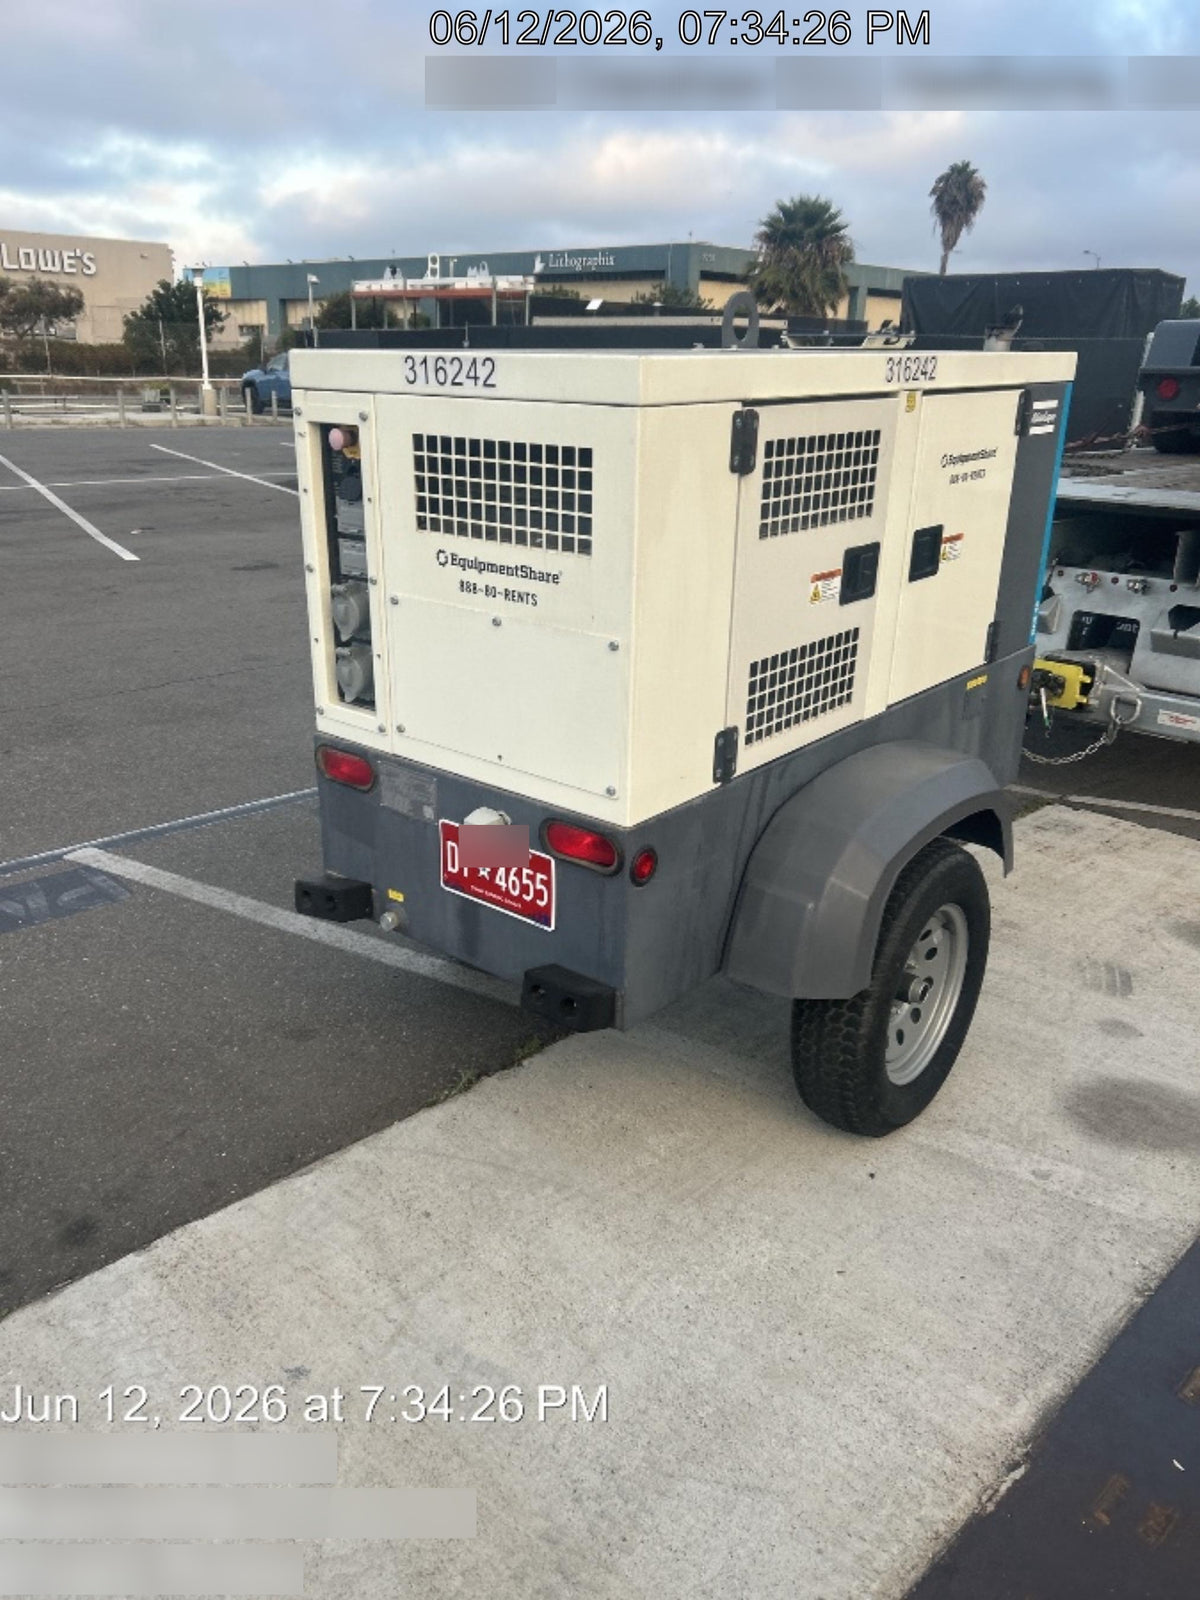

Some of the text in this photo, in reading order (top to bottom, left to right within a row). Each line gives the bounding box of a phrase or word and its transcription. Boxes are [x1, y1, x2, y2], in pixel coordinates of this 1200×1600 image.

[0, 243, 97, 275] LOWE'S
[404, 354, 497, 388] 316242
[885, 356, 938, 383] 316242
